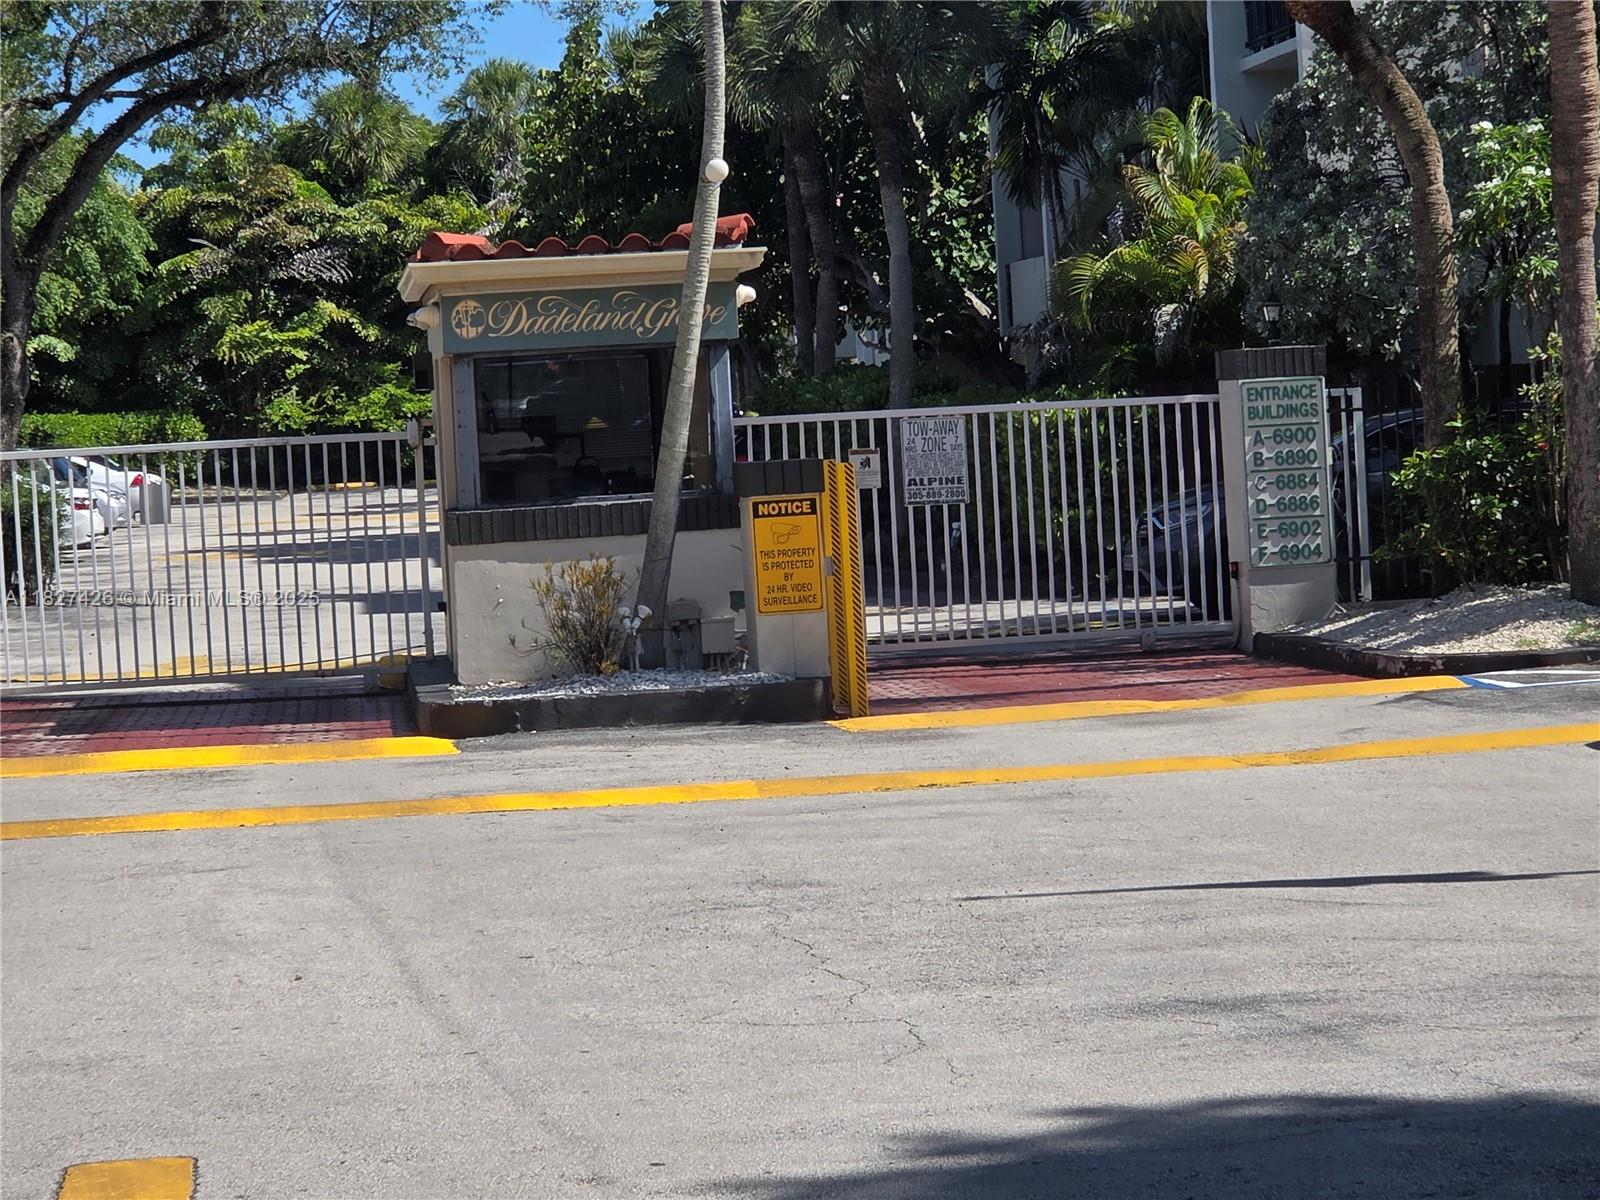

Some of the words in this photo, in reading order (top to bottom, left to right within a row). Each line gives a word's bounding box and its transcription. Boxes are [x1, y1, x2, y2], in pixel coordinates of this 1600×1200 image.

[488, 290, 645, 338] Dadeland
[636, 297, 728, 338] Grve
[1246, 384, 1317, 402] ENTRANCE
[1247, 402, 1319, 420] BUILDINGS
[907, 419, 960, 437] TOW-AWAY
[907, 438, 916, 446] 24
[1253, 427, 1317, 446] A-6900
[905, 446, 918, 454] HRS
[921, 437, 947, 453] ZONE
[950, 443, 964, 451] DAYS
[1253, 448, 1318, 467] B-6890
[907, 476, 965, 487] ALPINE
[1254, 473, 1319, 492] C-6884
[907, 489, 965, 500] 305-889-2800
[757, 500, 812, 516] NOTICE
[1255, 495, 1320, 514] D-6886
[1257, 520, 1321, 539] E-6902
[759, 549, 776, 560] THIS
[776, 547, 816, 559] PROPERTY
[1258, 544, 1322, 563] F-6904
[762, 562, 770, 571] IS
[770, 560, 814, 571] PROTECTED
[784, 572, 794, 582] BY
[767, 585, 776, 594] 24
[776, 584, 788, 594] HR.
[791, 583, 813, 593] VIDEO
[763, 594, 818, 607] SURVEILLANCE
